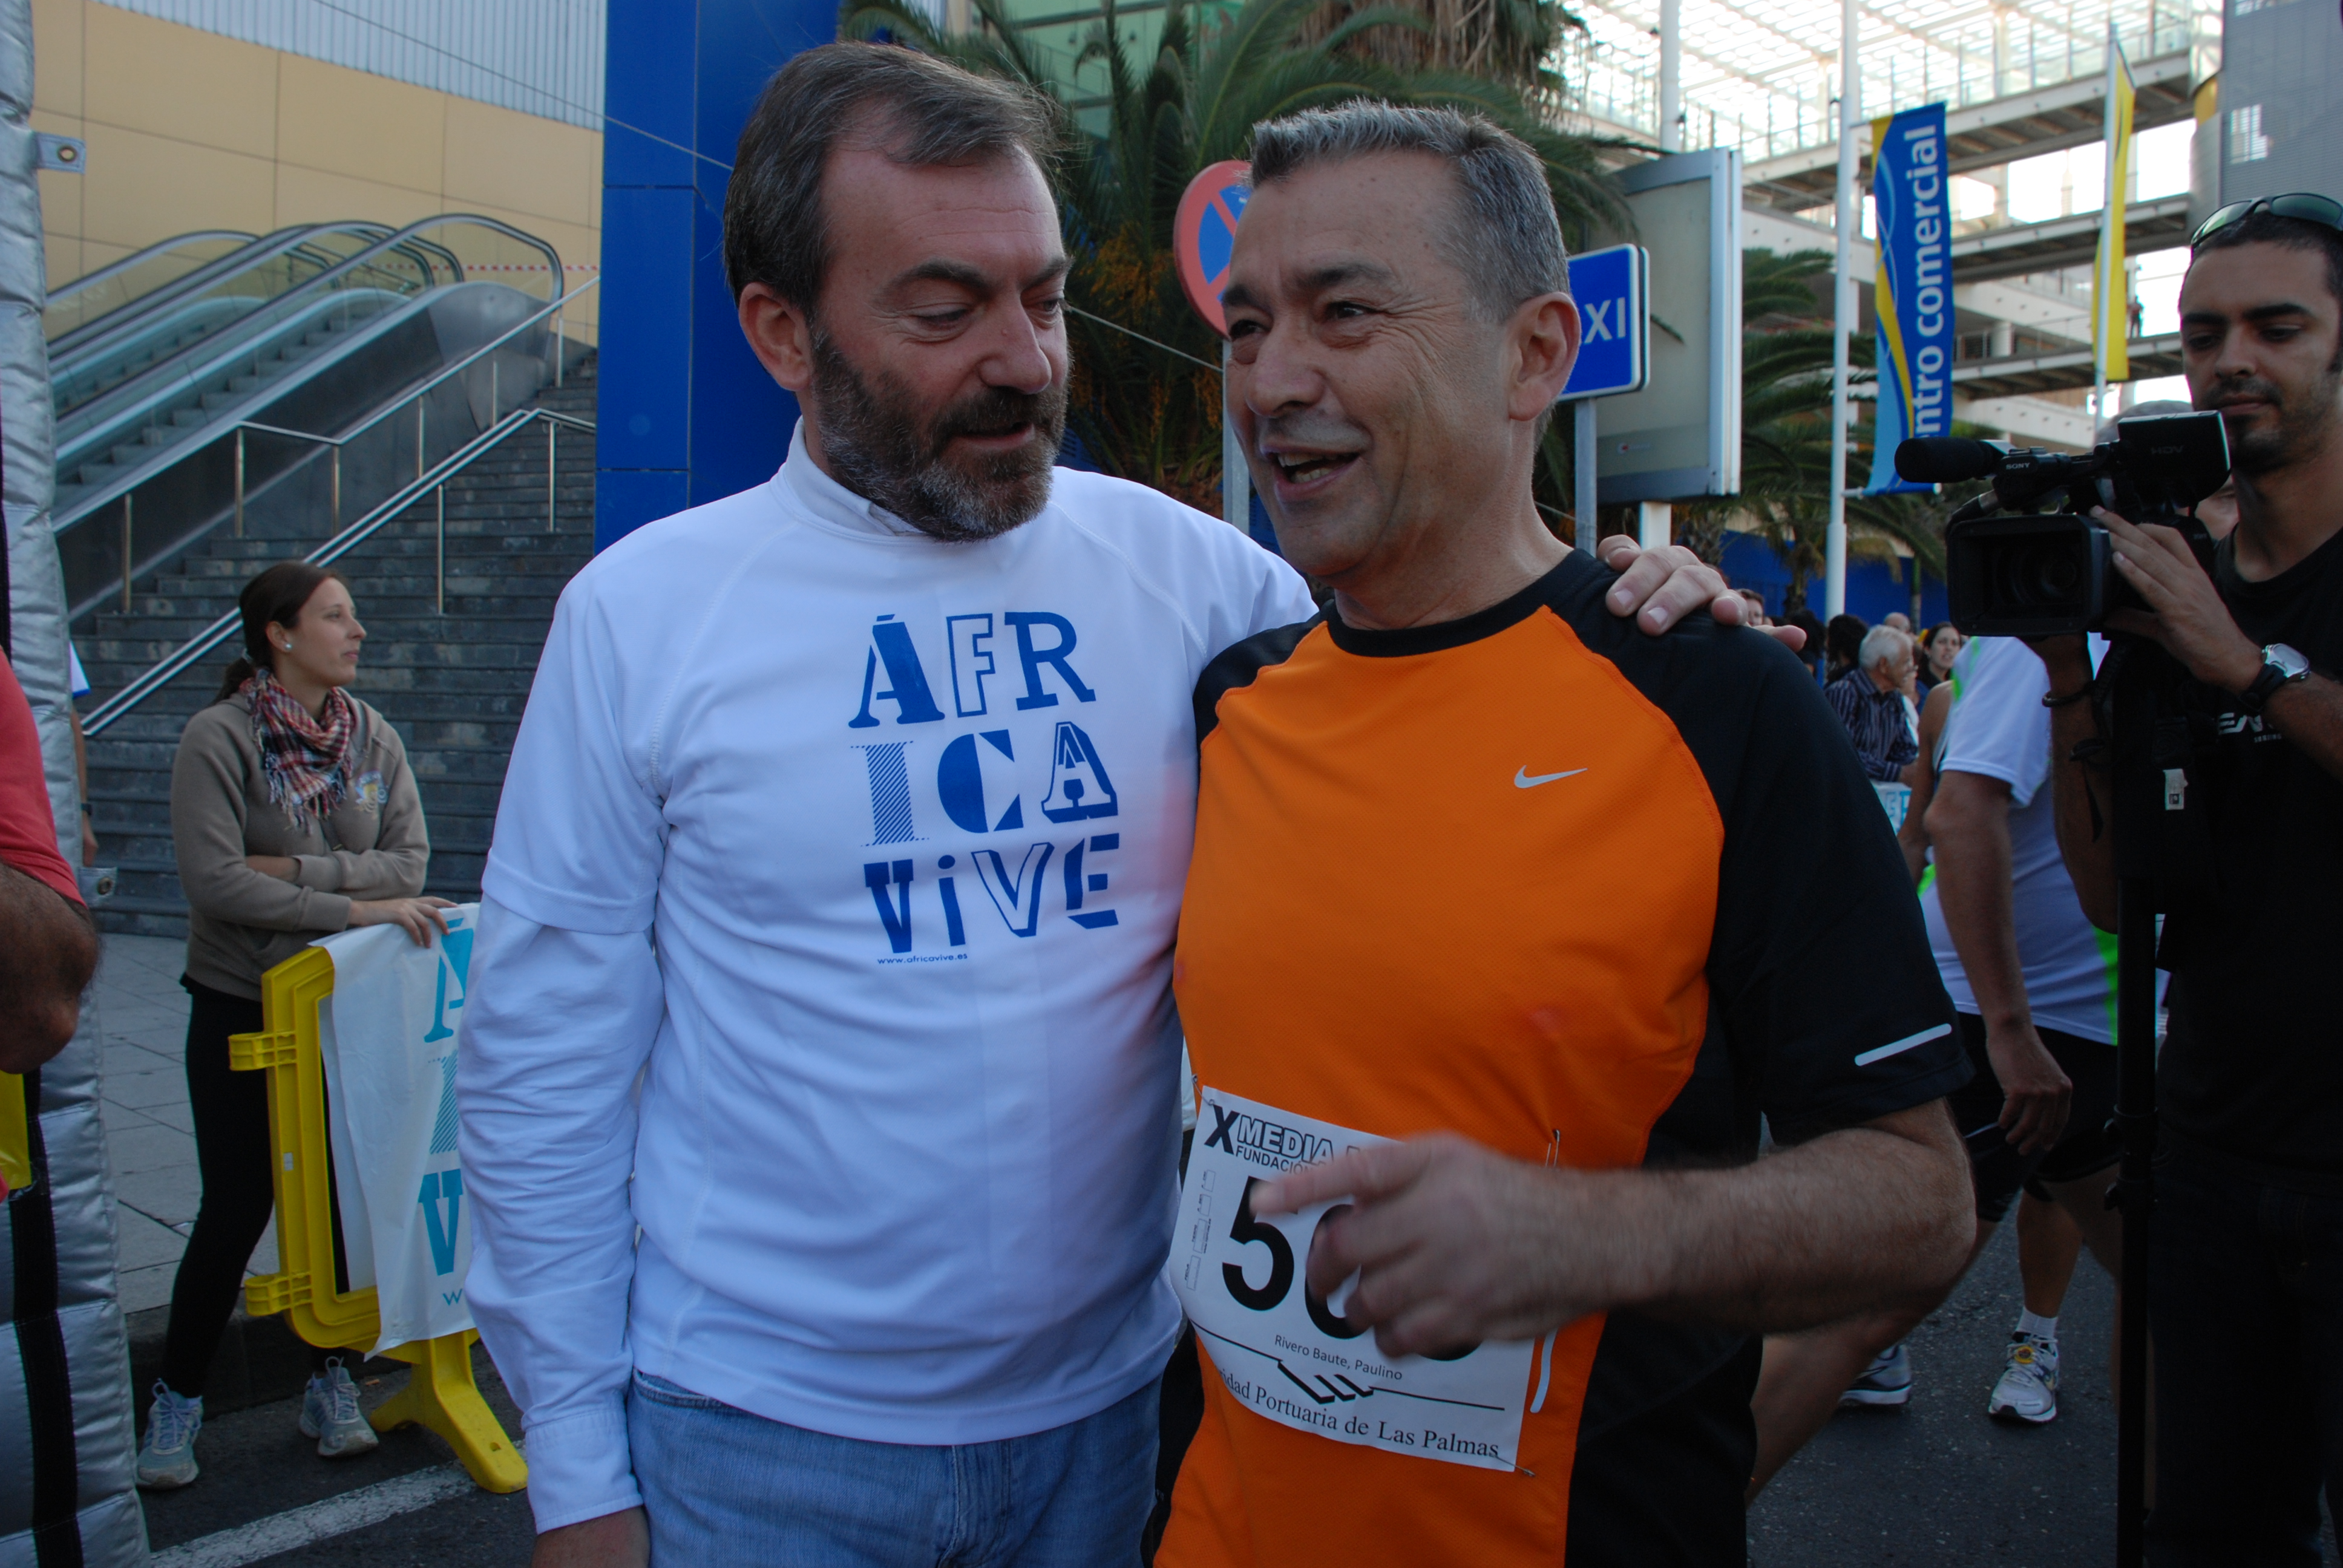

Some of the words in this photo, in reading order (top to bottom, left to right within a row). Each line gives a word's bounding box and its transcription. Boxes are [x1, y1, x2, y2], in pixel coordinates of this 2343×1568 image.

[1904, 124, 1943, 337] comercial
[1584, 296, 1626, 344] XI
[1912, 345, 1943, 437] ntro
[848, 612, 1096, 728] ÁFR
[850, 721, 1118, 847] ICA
[877, 953, 968, 964] www.africavive.es
[1204, 1104, 1240, 1155] X
[1237, 1114, 1334, 1166] MEDIA
[1275, 1334, 1309, 1356] Rivero
[1313, 1349, 1351, 1370] Baute,
[1355, 1359, 1402, 1381] Paulino
[1254, 1386, 1337, 1430] Portuaria
[1345, 1417, 1369, 1436] de
[1377, 1421, 1415, 1445] Las
[1422, 1430, 1498, 1457] Palmas
